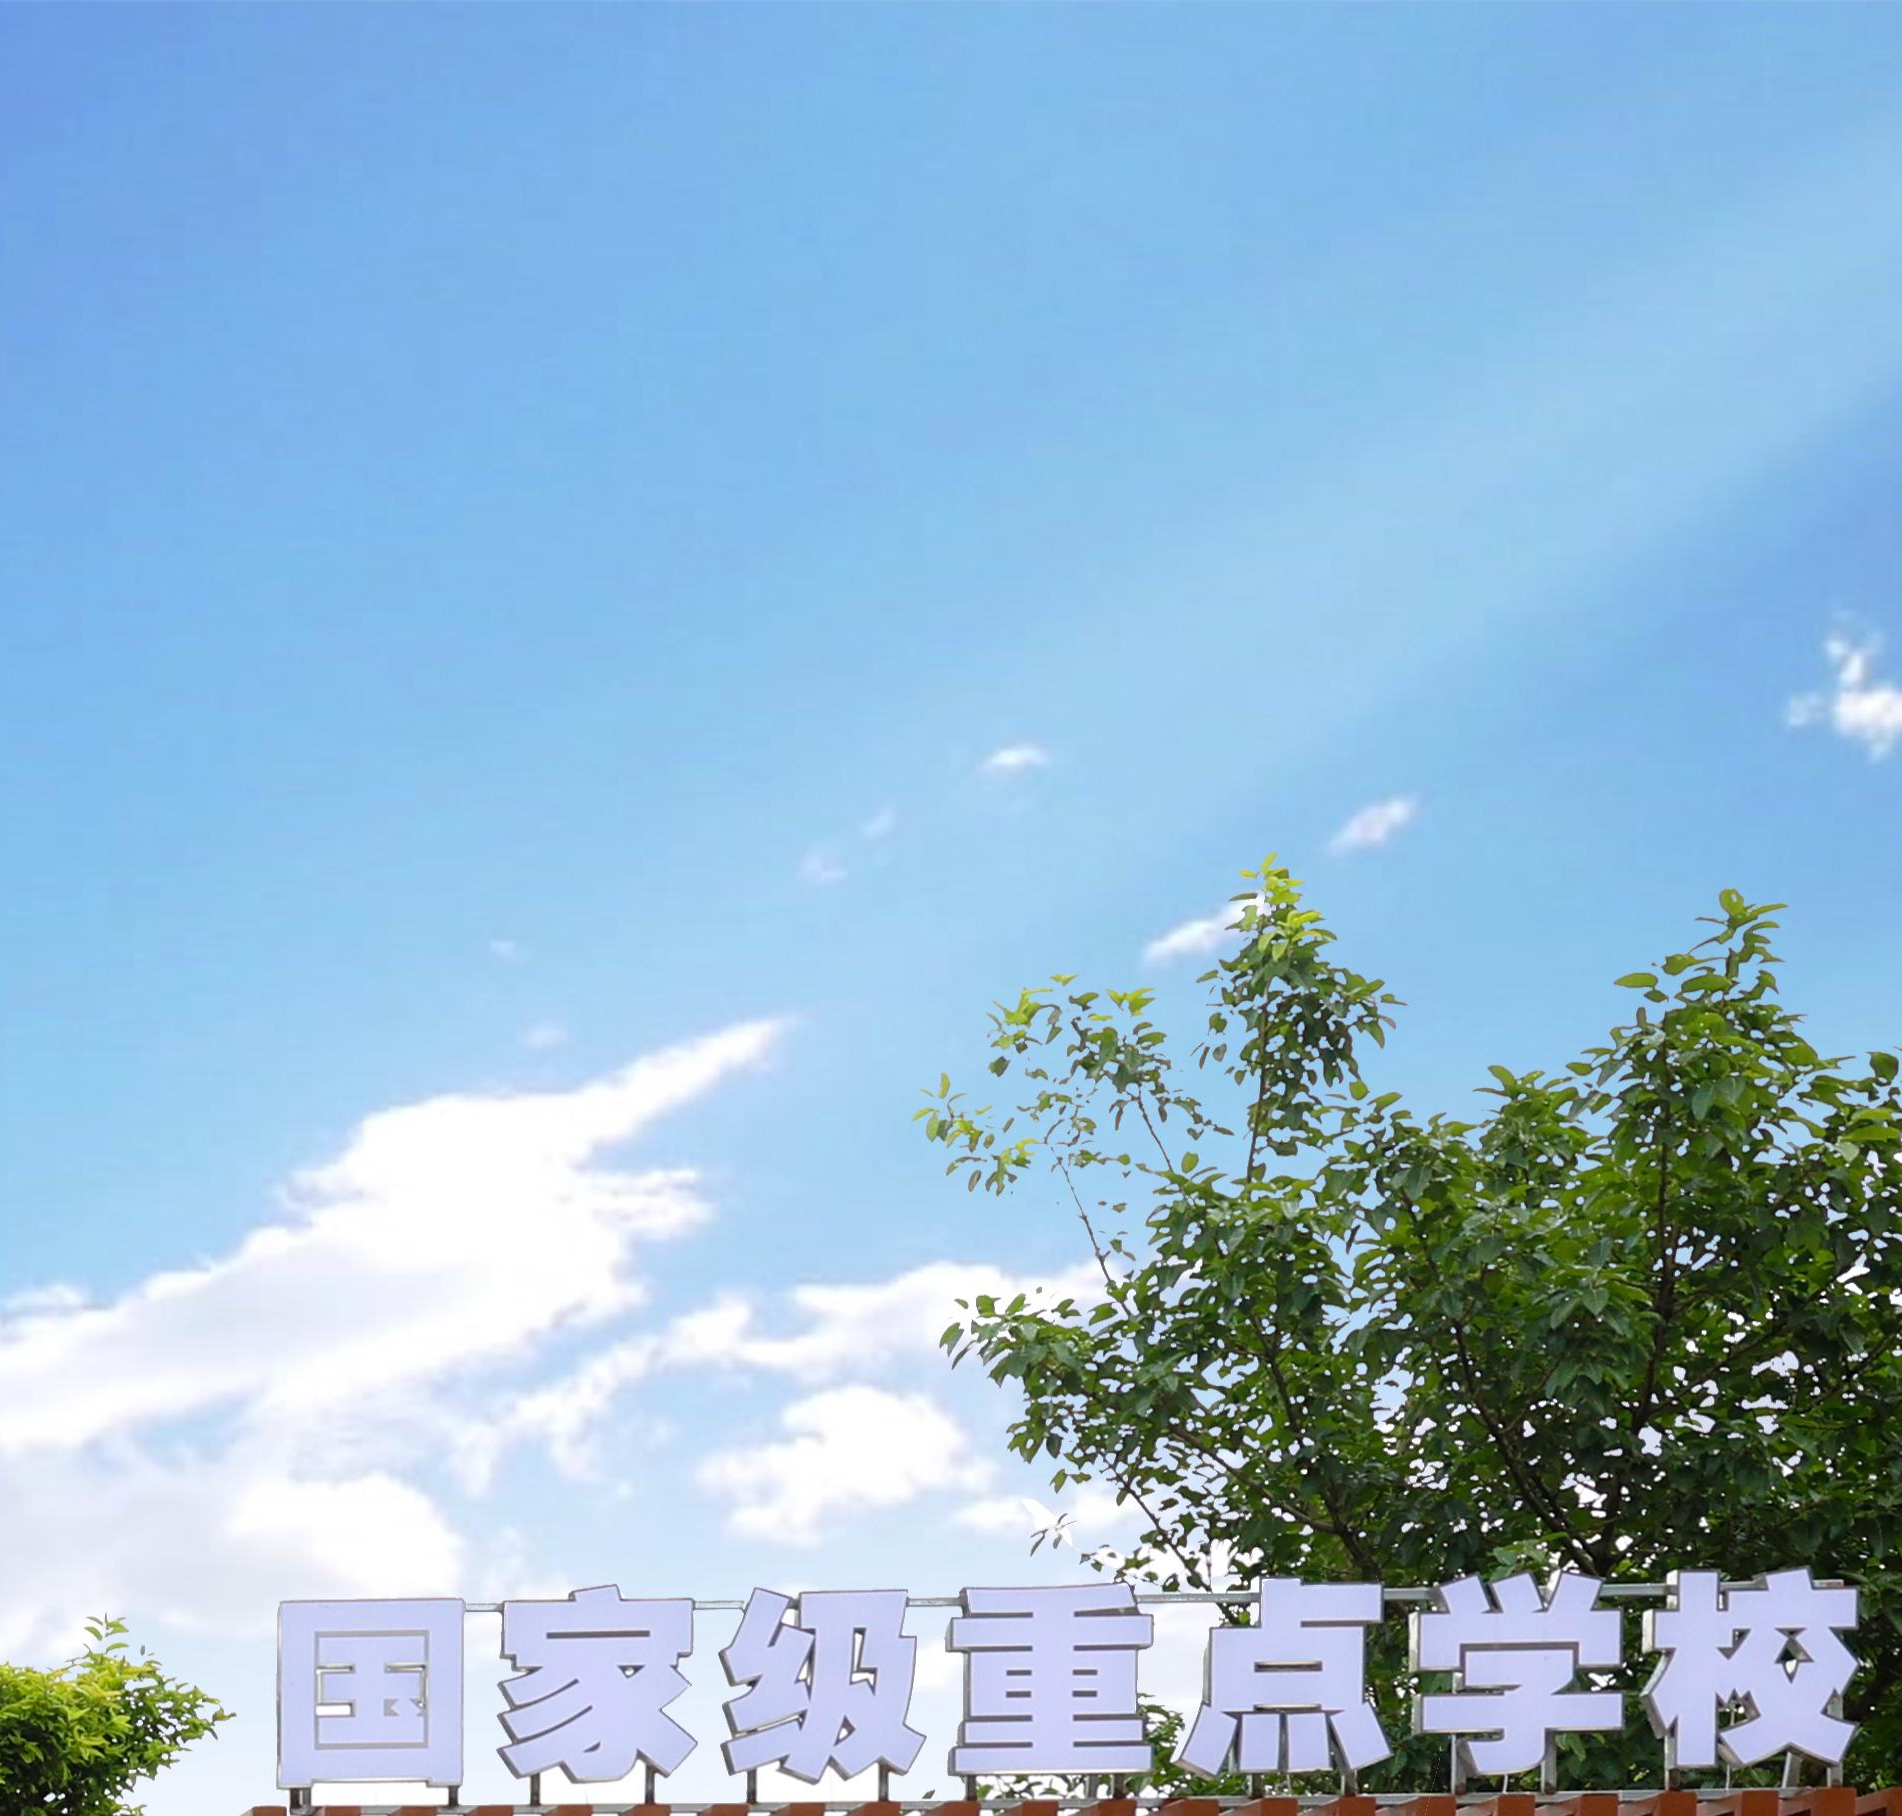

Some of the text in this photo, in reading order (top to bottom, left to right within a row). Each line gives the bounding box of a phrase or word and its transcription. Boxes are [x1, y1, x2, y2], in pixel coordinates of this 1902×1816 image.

[278, 1569, 1860, 1788] 国家级重点学校
